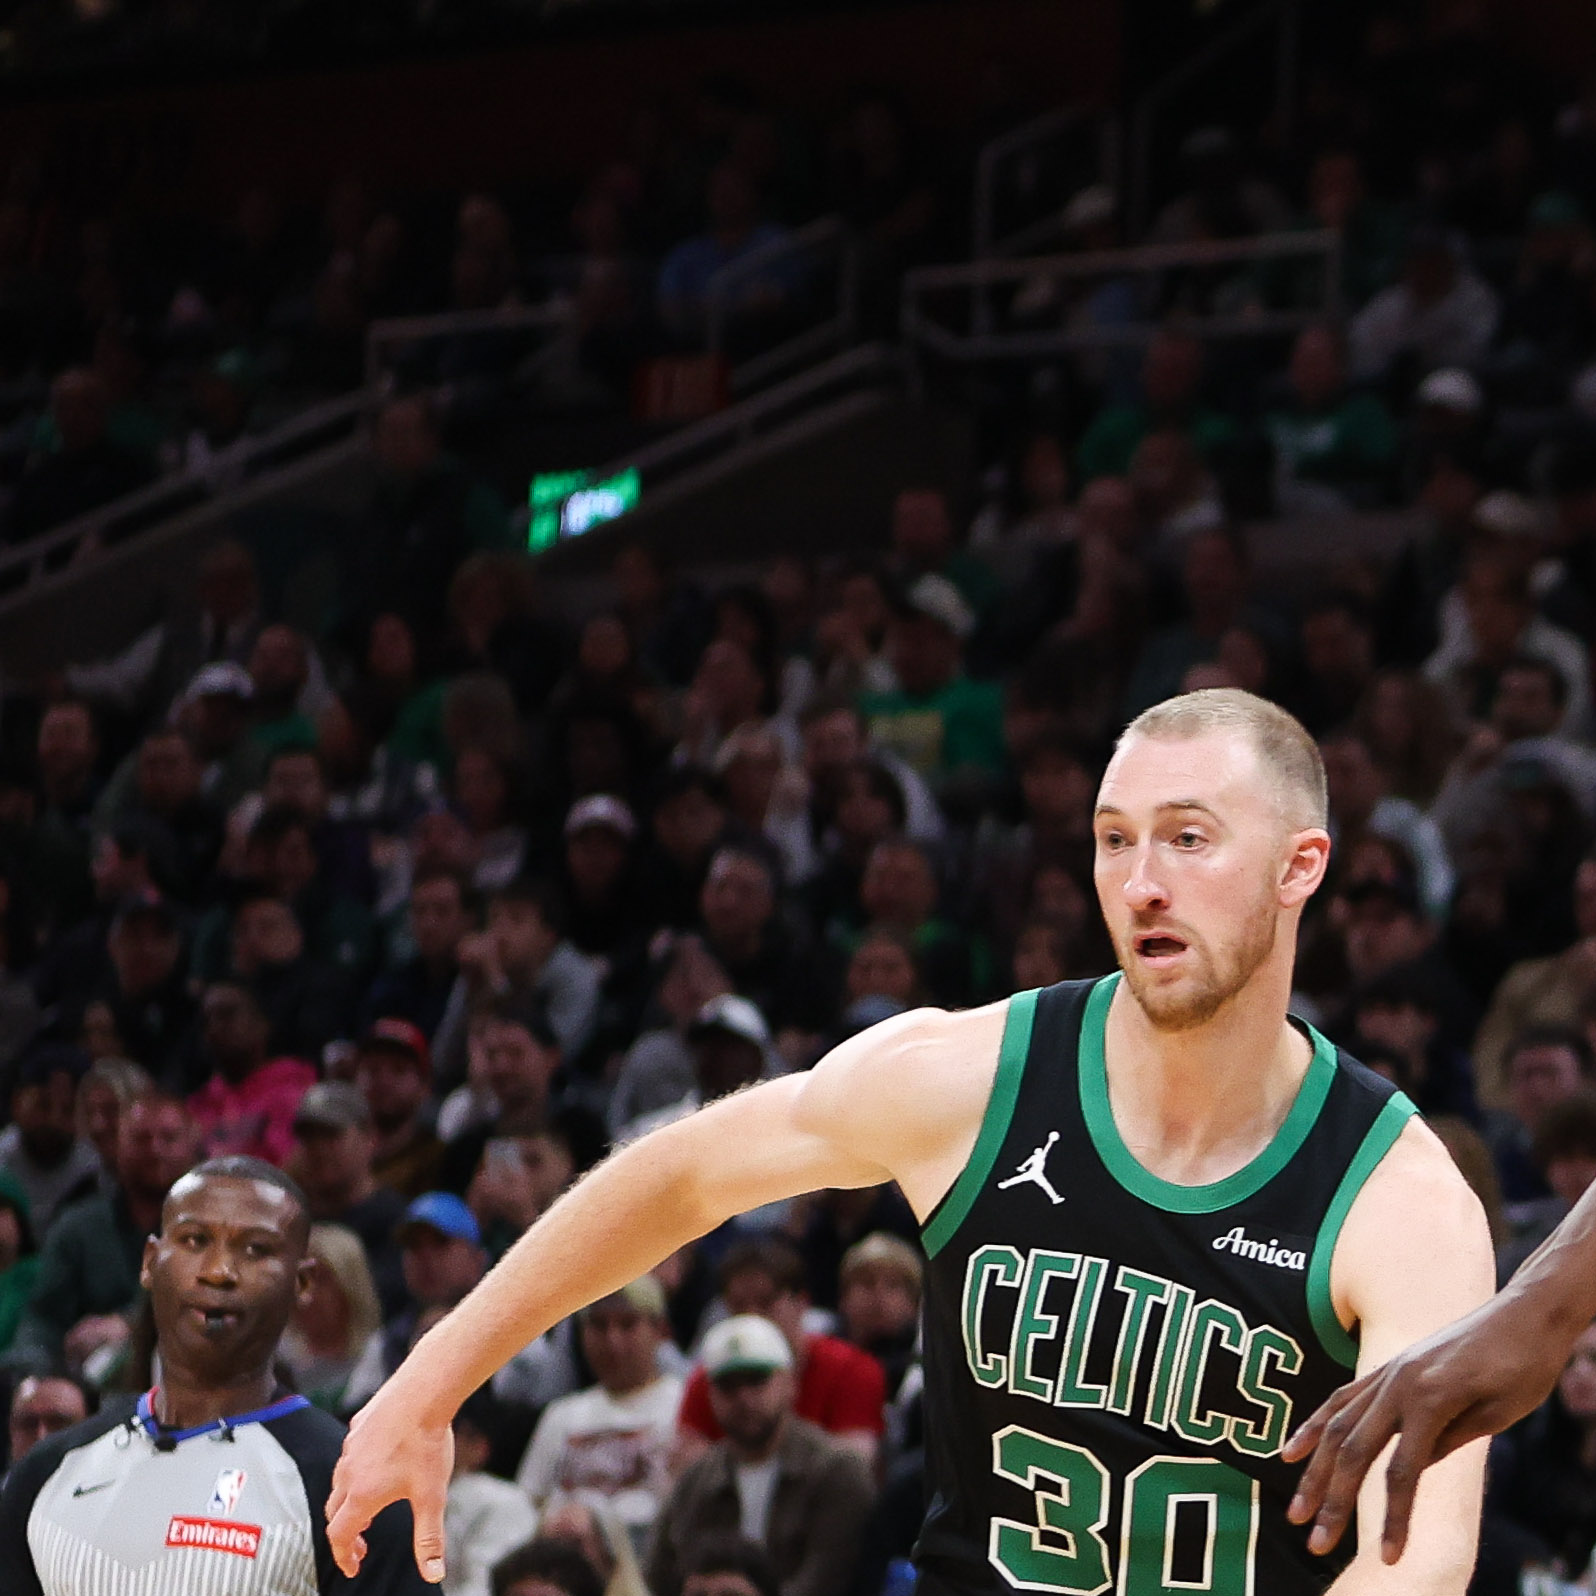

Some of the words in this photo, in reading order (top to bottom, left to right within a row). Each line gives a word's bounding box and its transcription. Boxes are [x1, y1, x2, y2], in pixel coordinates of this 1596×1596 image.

[1212, 1226, 1308, 1271] Amica
[961, 1244, 1305, 1459] CELTICS
[168, 1519, 260, 1553] Emirates
